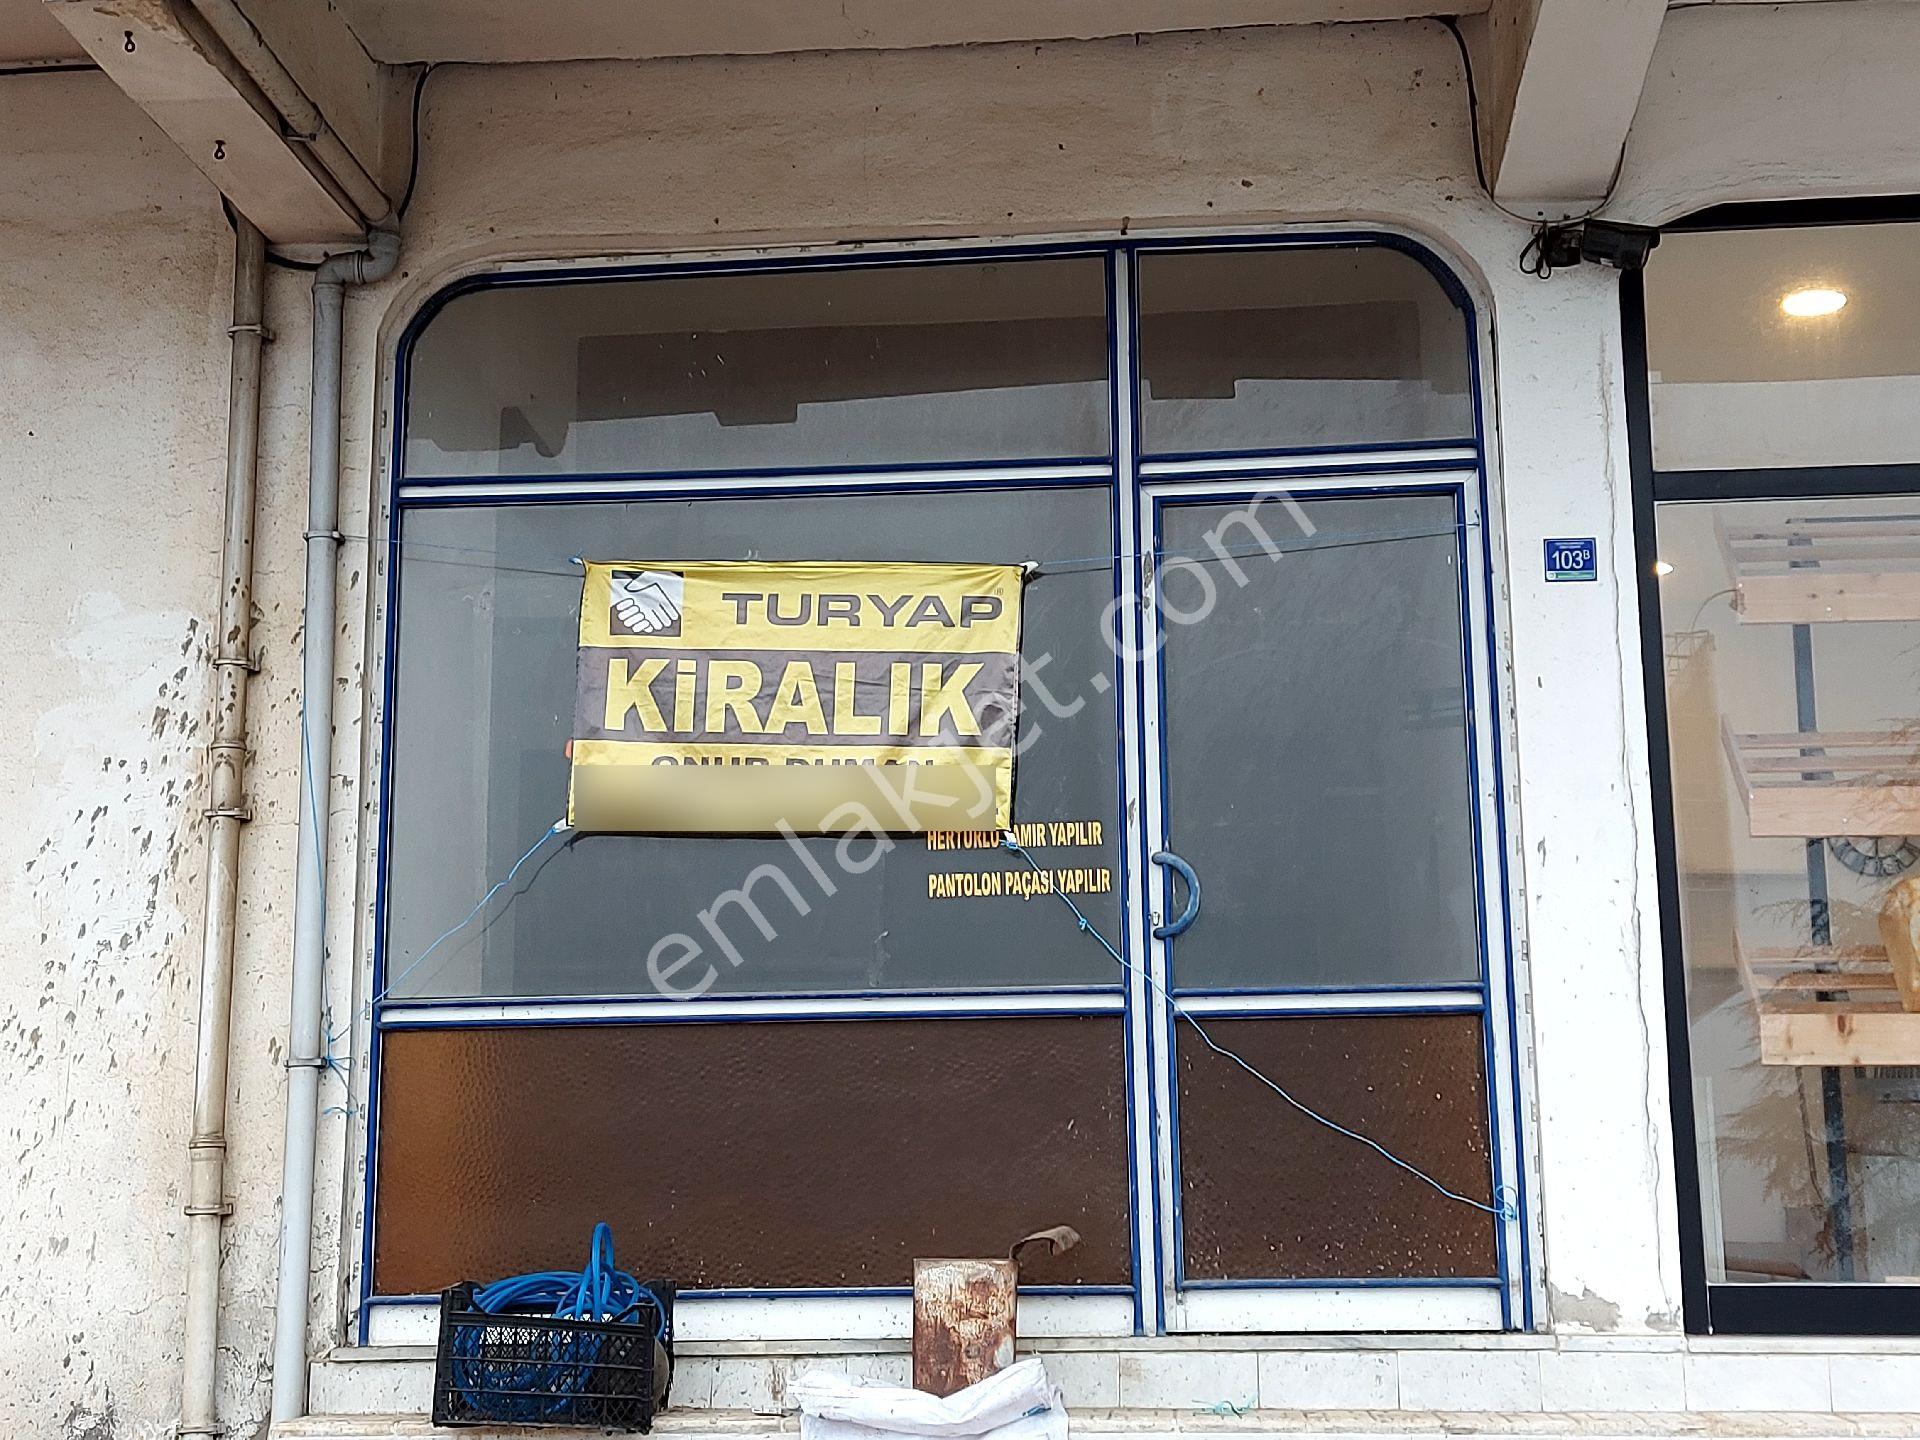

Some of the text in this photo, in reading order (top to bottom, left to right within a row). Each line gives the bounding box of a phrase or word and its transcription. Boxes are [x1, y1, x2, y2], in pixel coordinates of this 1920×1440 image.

[722, 593, 1003, 628] TURYAP
[1049, 822, 1102, 846] YAPILIR
[928, 869, 1110, 900] PANTOLON PAÇASI YAPILIR
